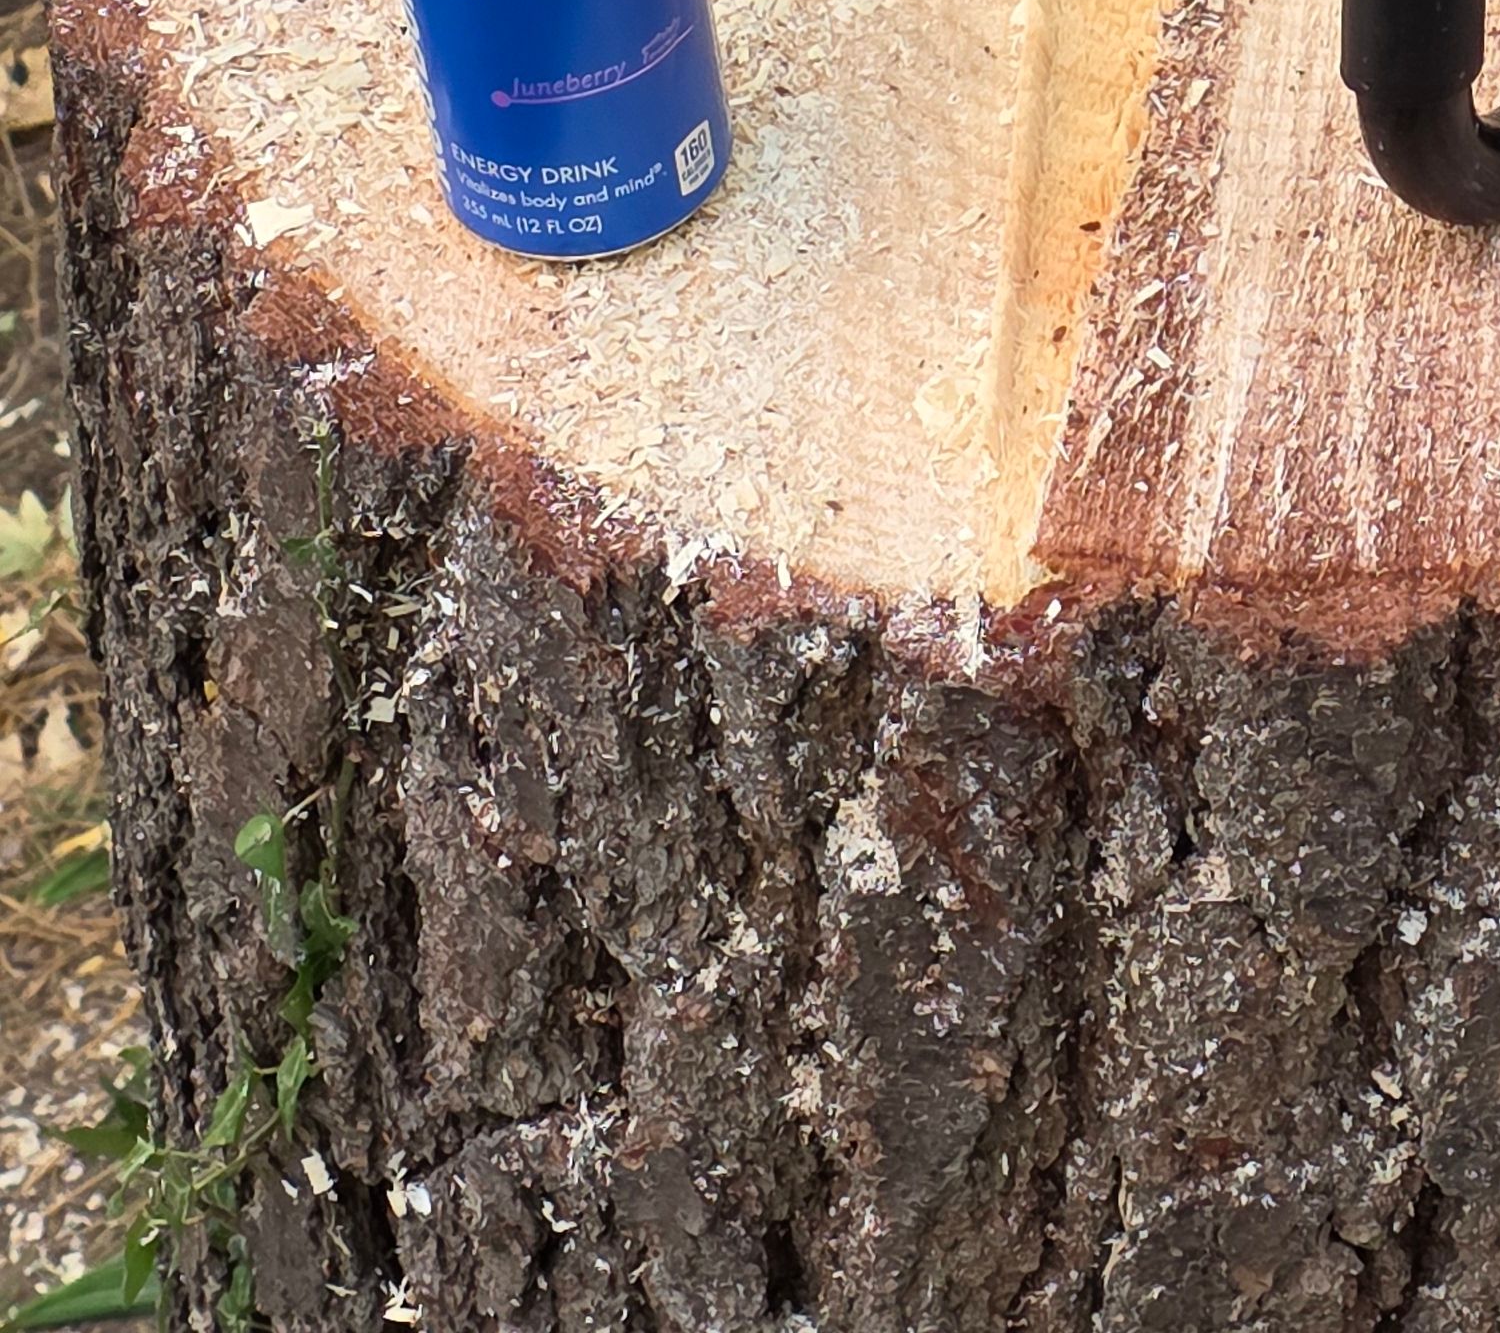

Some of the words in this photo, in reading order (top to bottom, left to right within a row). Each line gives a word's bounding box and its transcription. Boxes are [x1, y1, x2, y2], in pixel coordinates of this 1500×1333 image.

[512, 61, 627, 99] Juneberry
[450, 142, 533, 184] ENERGY
[541, 156, 619, 185] DRINK
[681, 129, 707, 167] 160
[521, 190, 567, 213] body
[573, 188, 609, 206] and
[516, 216, 541, 236] (12
[547, 219, 565, 236] FL
[568, 215, 603, 235] OZ)
